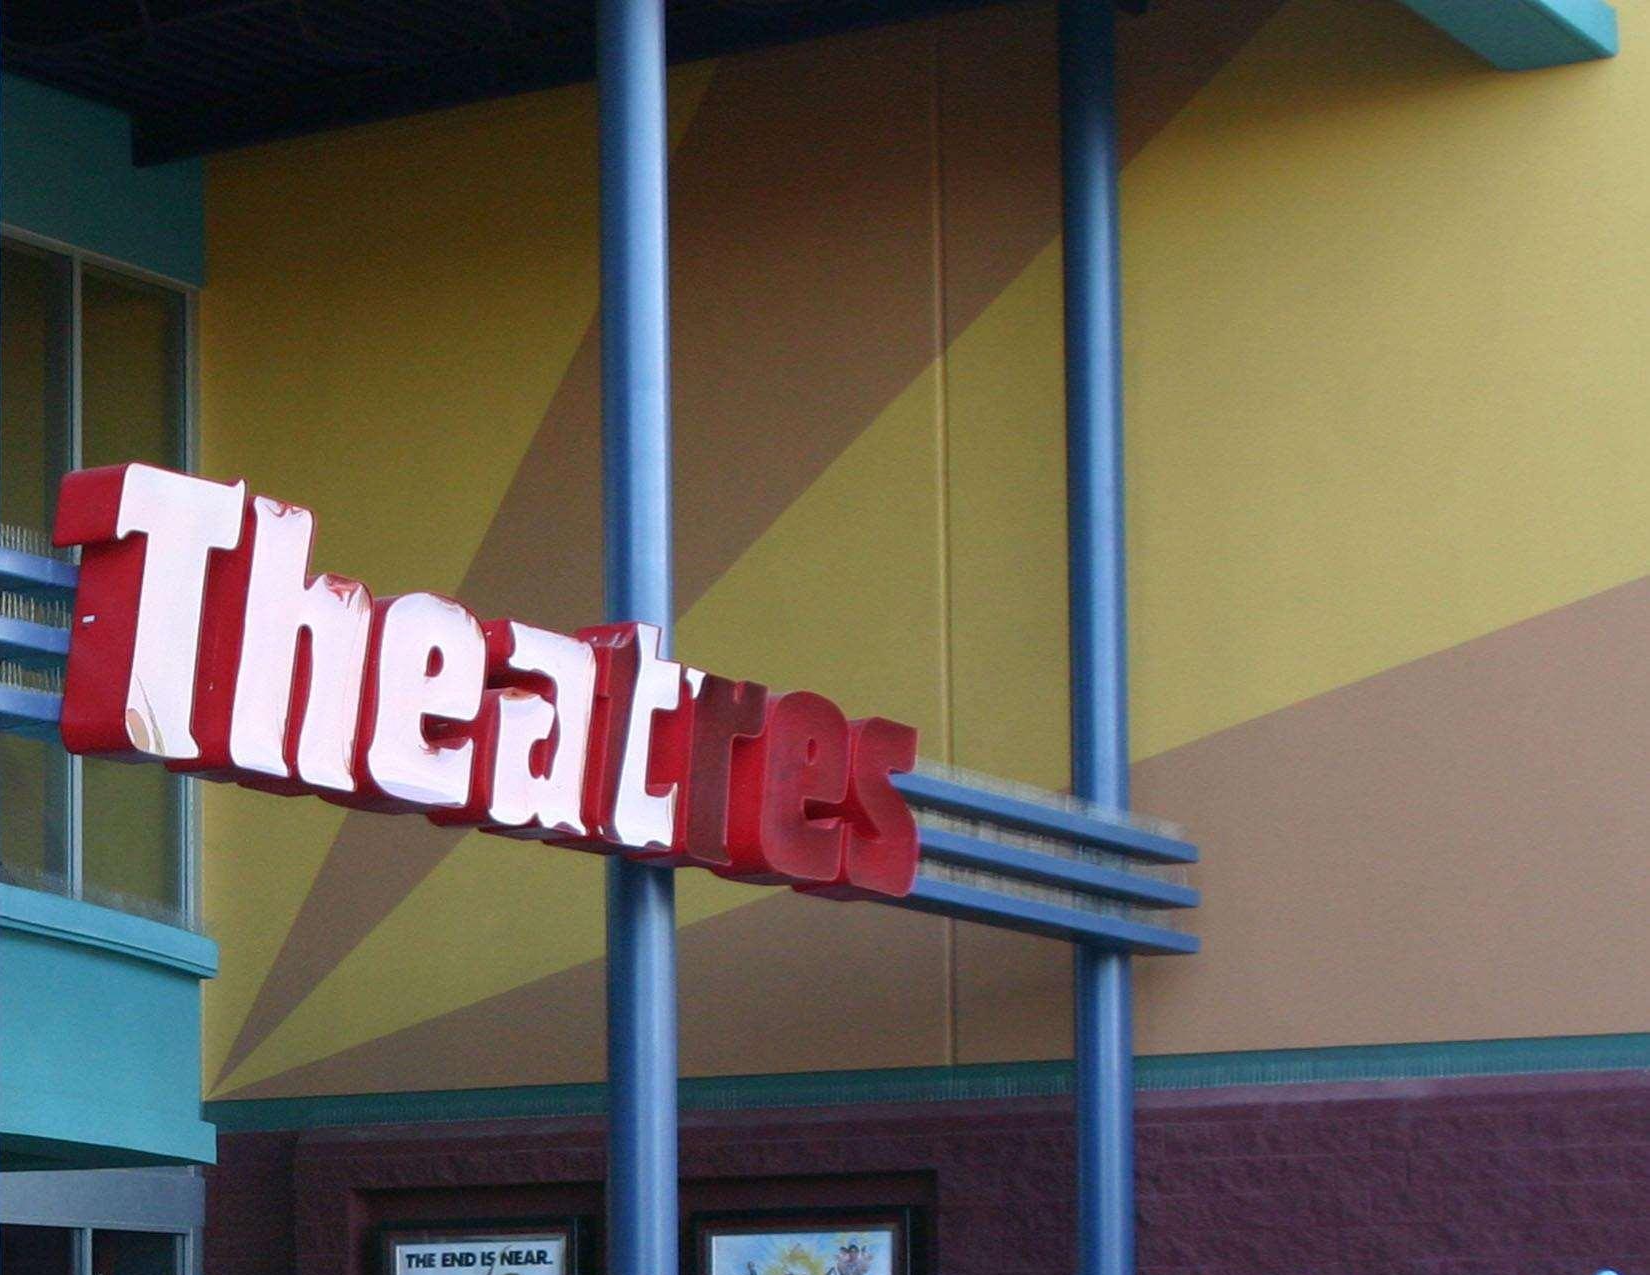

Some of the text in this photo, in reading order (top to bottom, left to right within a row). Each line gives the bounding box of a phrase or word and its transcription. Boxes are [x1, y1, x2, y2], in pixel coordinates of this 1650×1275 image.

[95, 462, 920, 898] Theatres
[406, 1250, 553, 1268] THE END IS NEAR.
